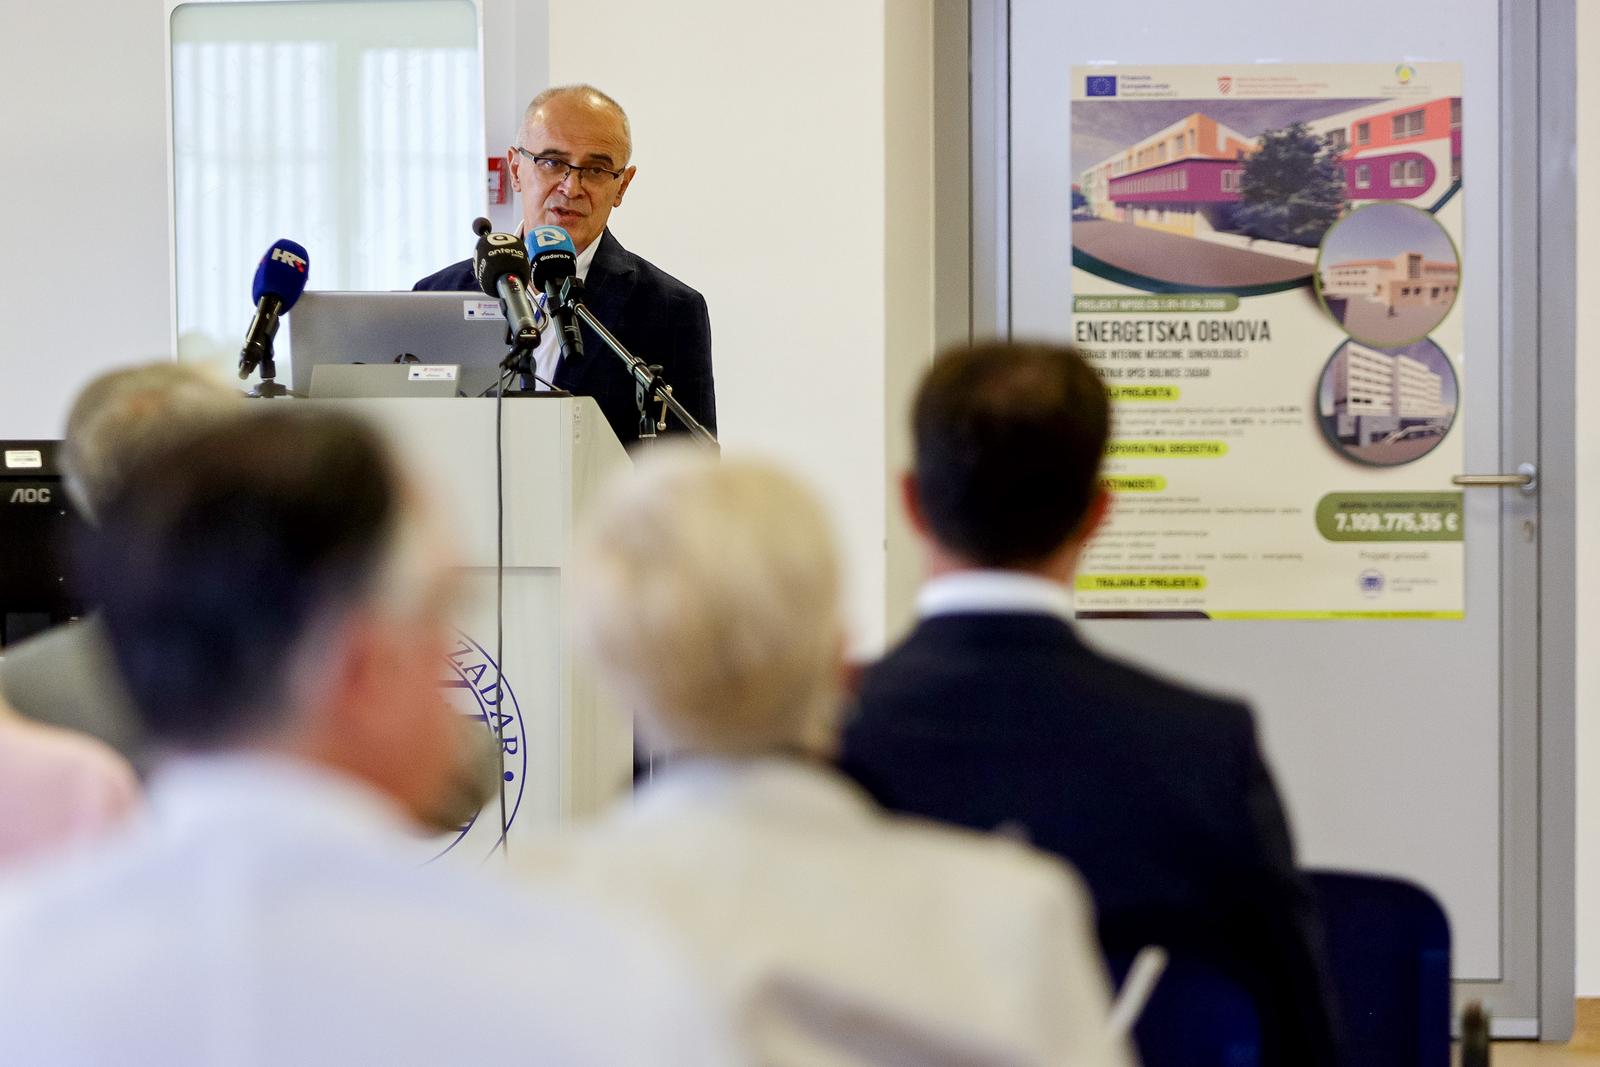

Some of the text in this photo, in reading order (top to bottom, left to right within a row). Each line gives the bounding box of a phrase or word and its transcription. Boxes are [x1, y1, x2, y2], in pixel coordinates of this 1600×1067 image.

[487, 248, 524, 258] antena
[1076, 321, 1272, 342] ENERGETSKA OBNOVA
[9, 488, 51, 503] AOC
[1444, 512, 1459, 533] €
[446, 640, 518, 756] ZADAR
